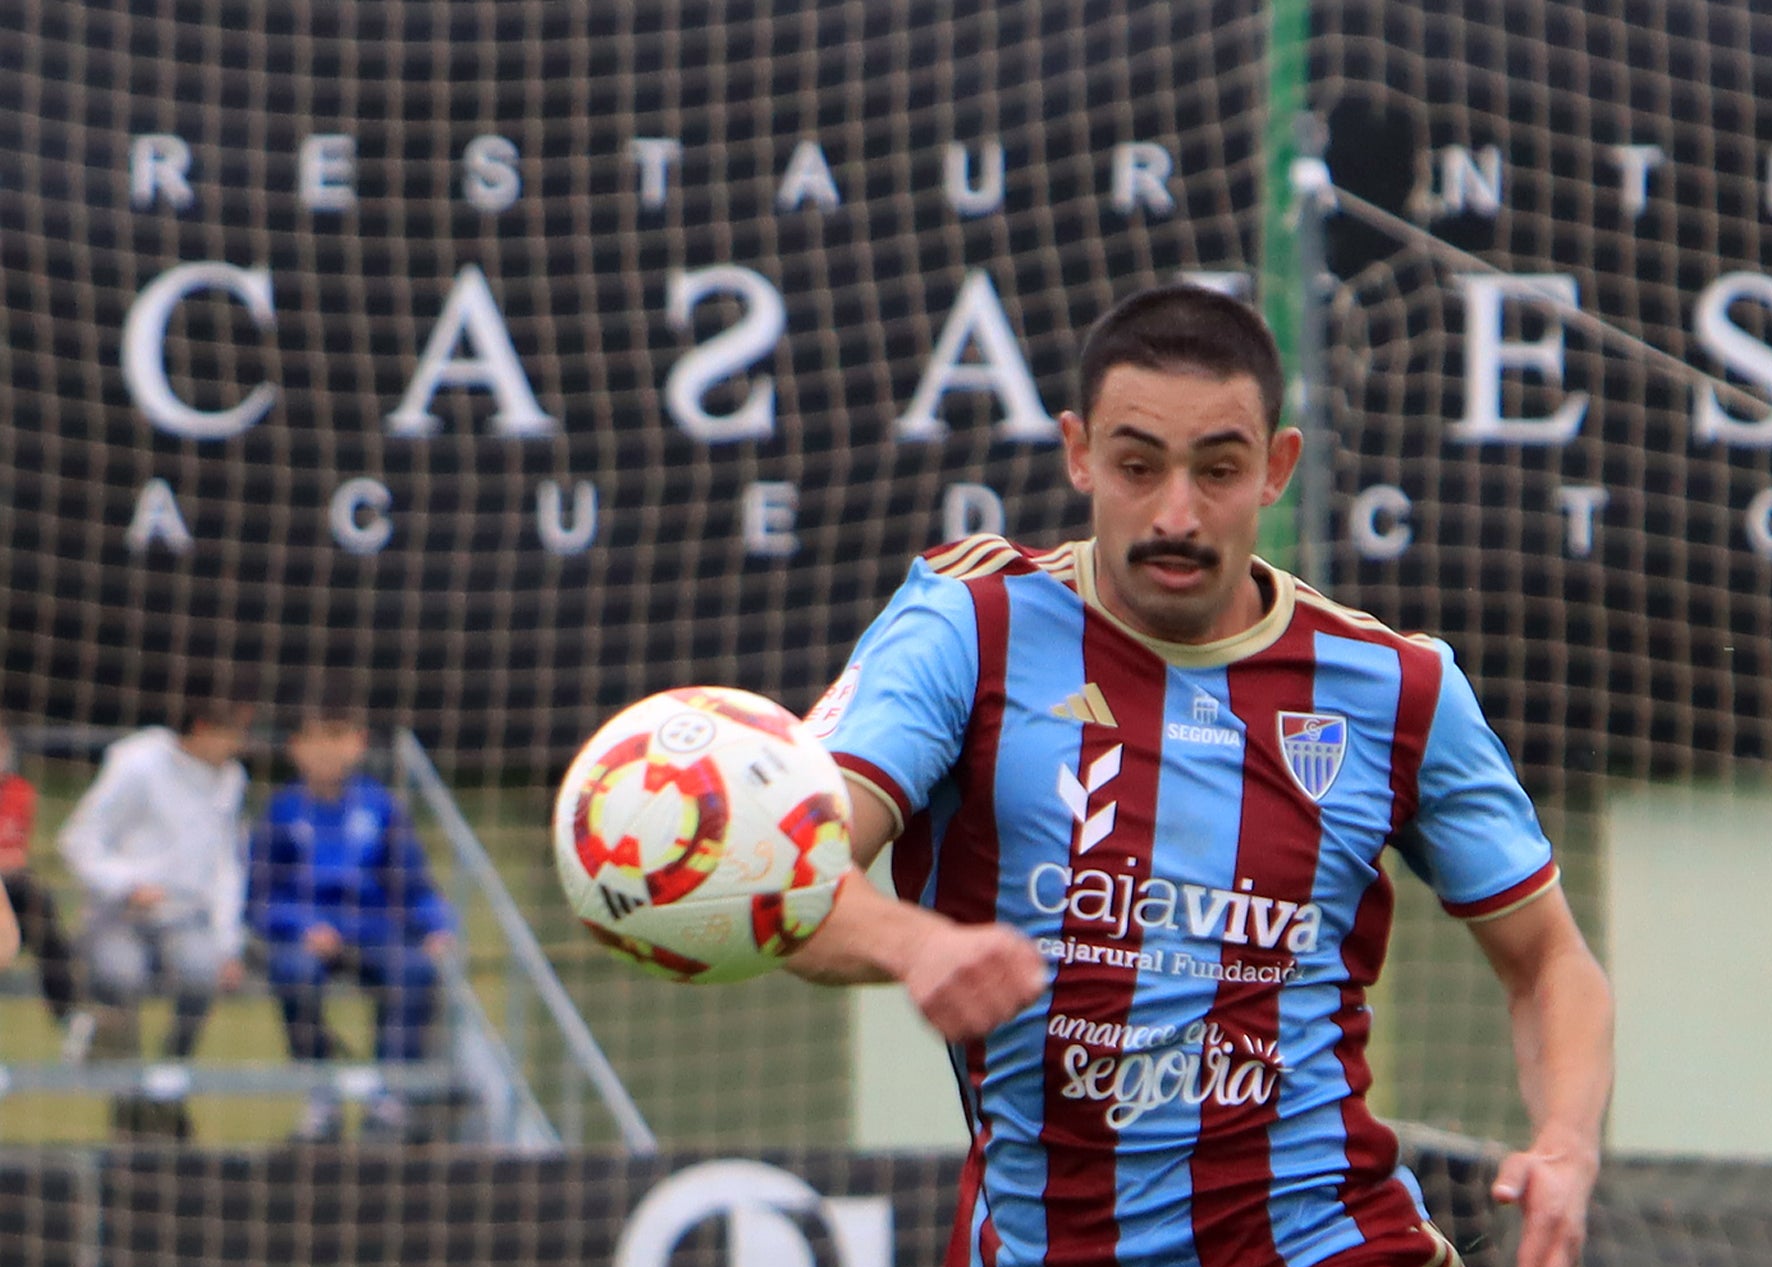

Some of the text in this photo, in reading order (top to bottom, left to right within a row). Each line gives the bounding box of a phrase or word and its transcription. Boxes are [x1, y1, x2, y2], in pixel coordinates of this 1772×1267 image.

[1167, 722, 1241, 747] SEGOVIA
[1028, 856, 1322, 953] cajaviva
[1048, 1013, 1225, 1050] amanece en
